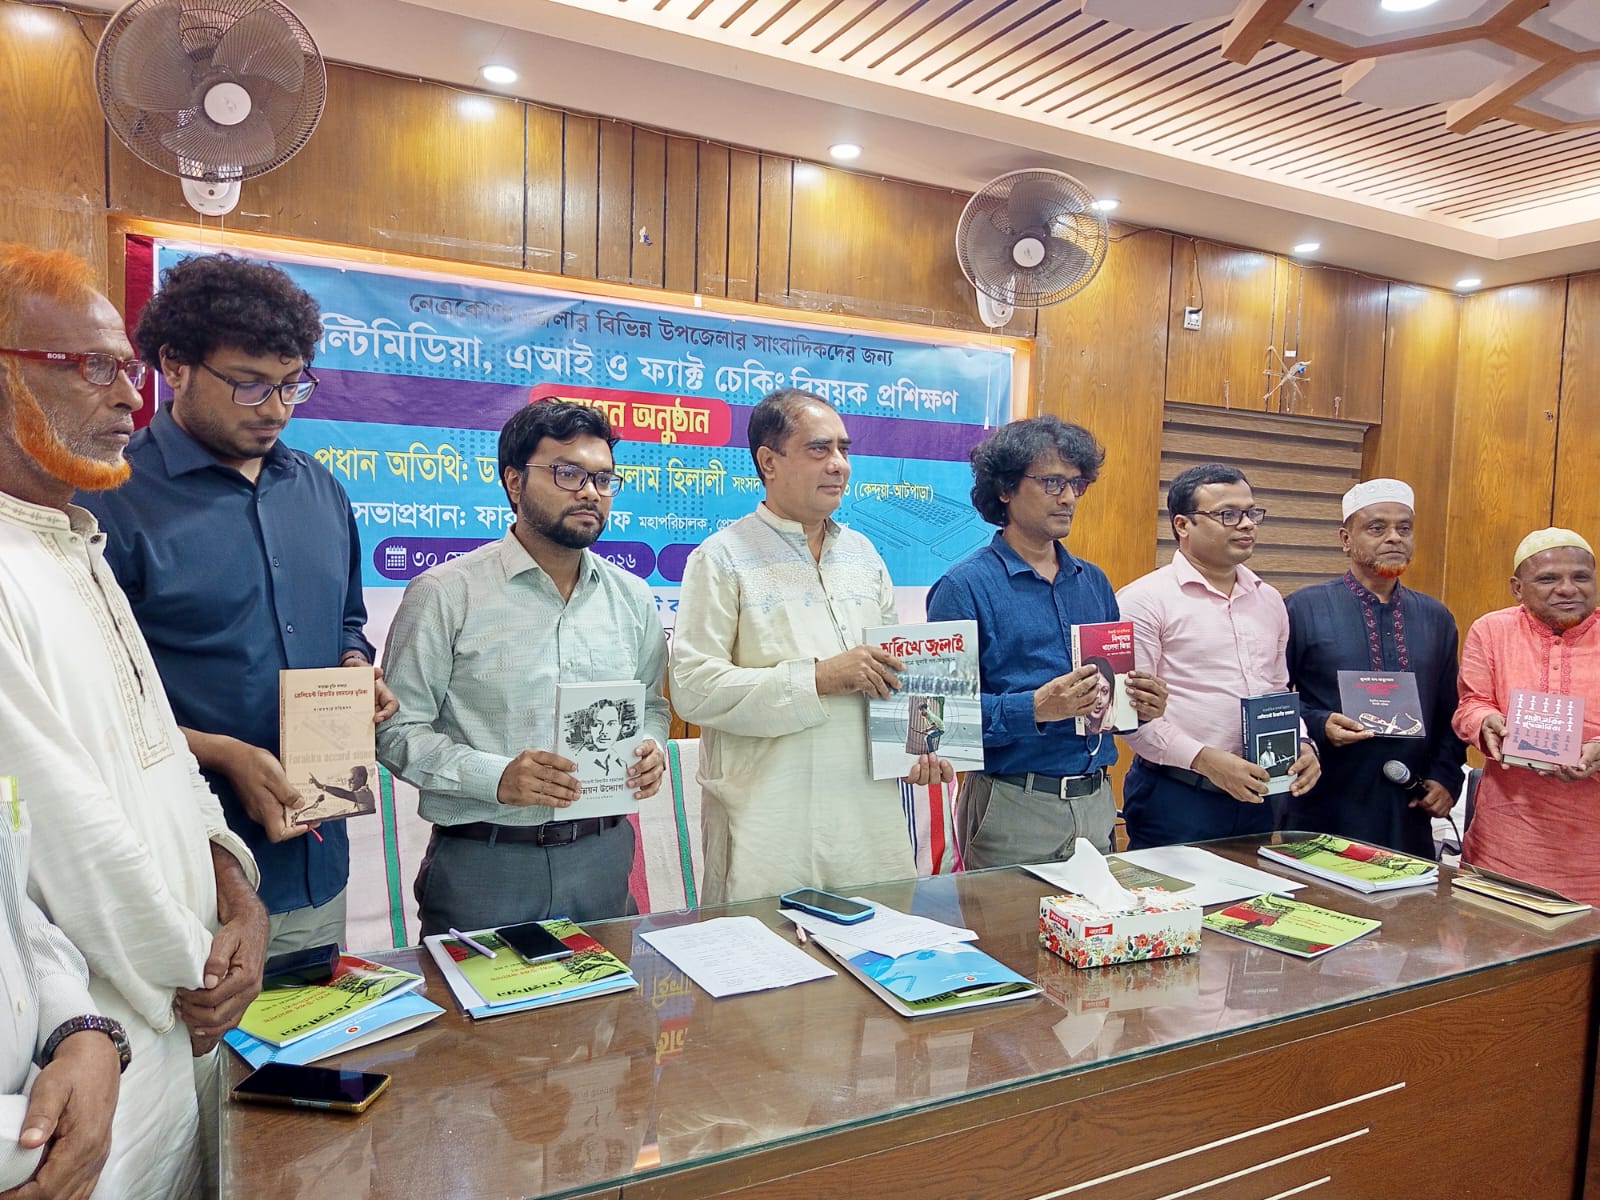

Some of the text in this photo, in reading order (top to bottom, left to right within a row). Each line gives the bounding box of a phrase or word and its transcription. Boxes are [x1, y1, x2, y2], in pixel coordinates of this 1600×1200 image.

[596, 309, 651, 338] বিভিন্ন
[658, 315, 747, 351] উপজেলার
[752, 334, 856, 363] সাংবাদিকদের
[861, 346, 893, 367] জন্য
[319, 312, 492, 375] ল্টিমিডিয়া,
[506, 338, 594, 382] এআই
[605, 354, 628, 381] ও
[637, 352, 706, 391] ফ্যাক্ট
[715, 359, 785, 395] চেকিং
[877, 377, 959, 415] প্রশিক্ষণ
[632, 397, 710, 444] অনুষ্ঠান
[385, 441, 469, 485] অতিথি:
[666, 458, 727, 496] হিলালী
[352, 501, 467, 529] সভাপ্রধান:
[639, 513, 712, 532] মহাপরিচালক,
[412, 551, 437, 567] ৩০
[606, 553, 637, 569] ০২৬
[925, 633, 965, 657] জুলাই
